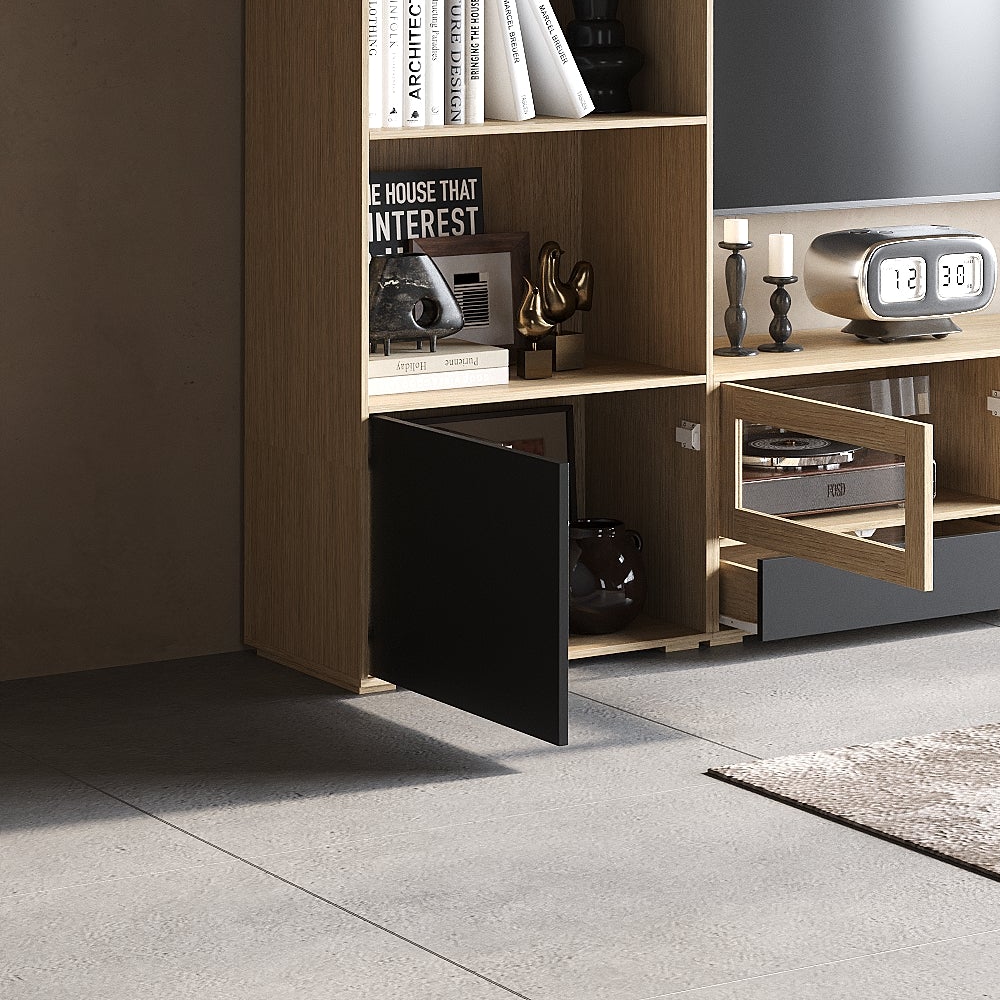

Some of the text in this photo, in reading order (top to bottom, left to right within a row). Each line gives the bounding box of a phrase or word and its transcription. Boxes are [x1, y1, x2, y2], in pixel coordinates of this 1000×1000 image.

[470, 25, 480, 41] THE
[509, 31, 520, 64] BREUER
[538, 4, 554, 36] MARCEL
[551, 34, 568, 65] BREUER
[470, 43, 480, 80] BRINGING
[450, 48, 462, 123] DESIGN
[385, 180, 436, 205] HOUSE
[440, 178, 478, 202] THAT
[895, 265, 965, 289] 12 30
[396, 356, 479, 373] Purienne Holiday
